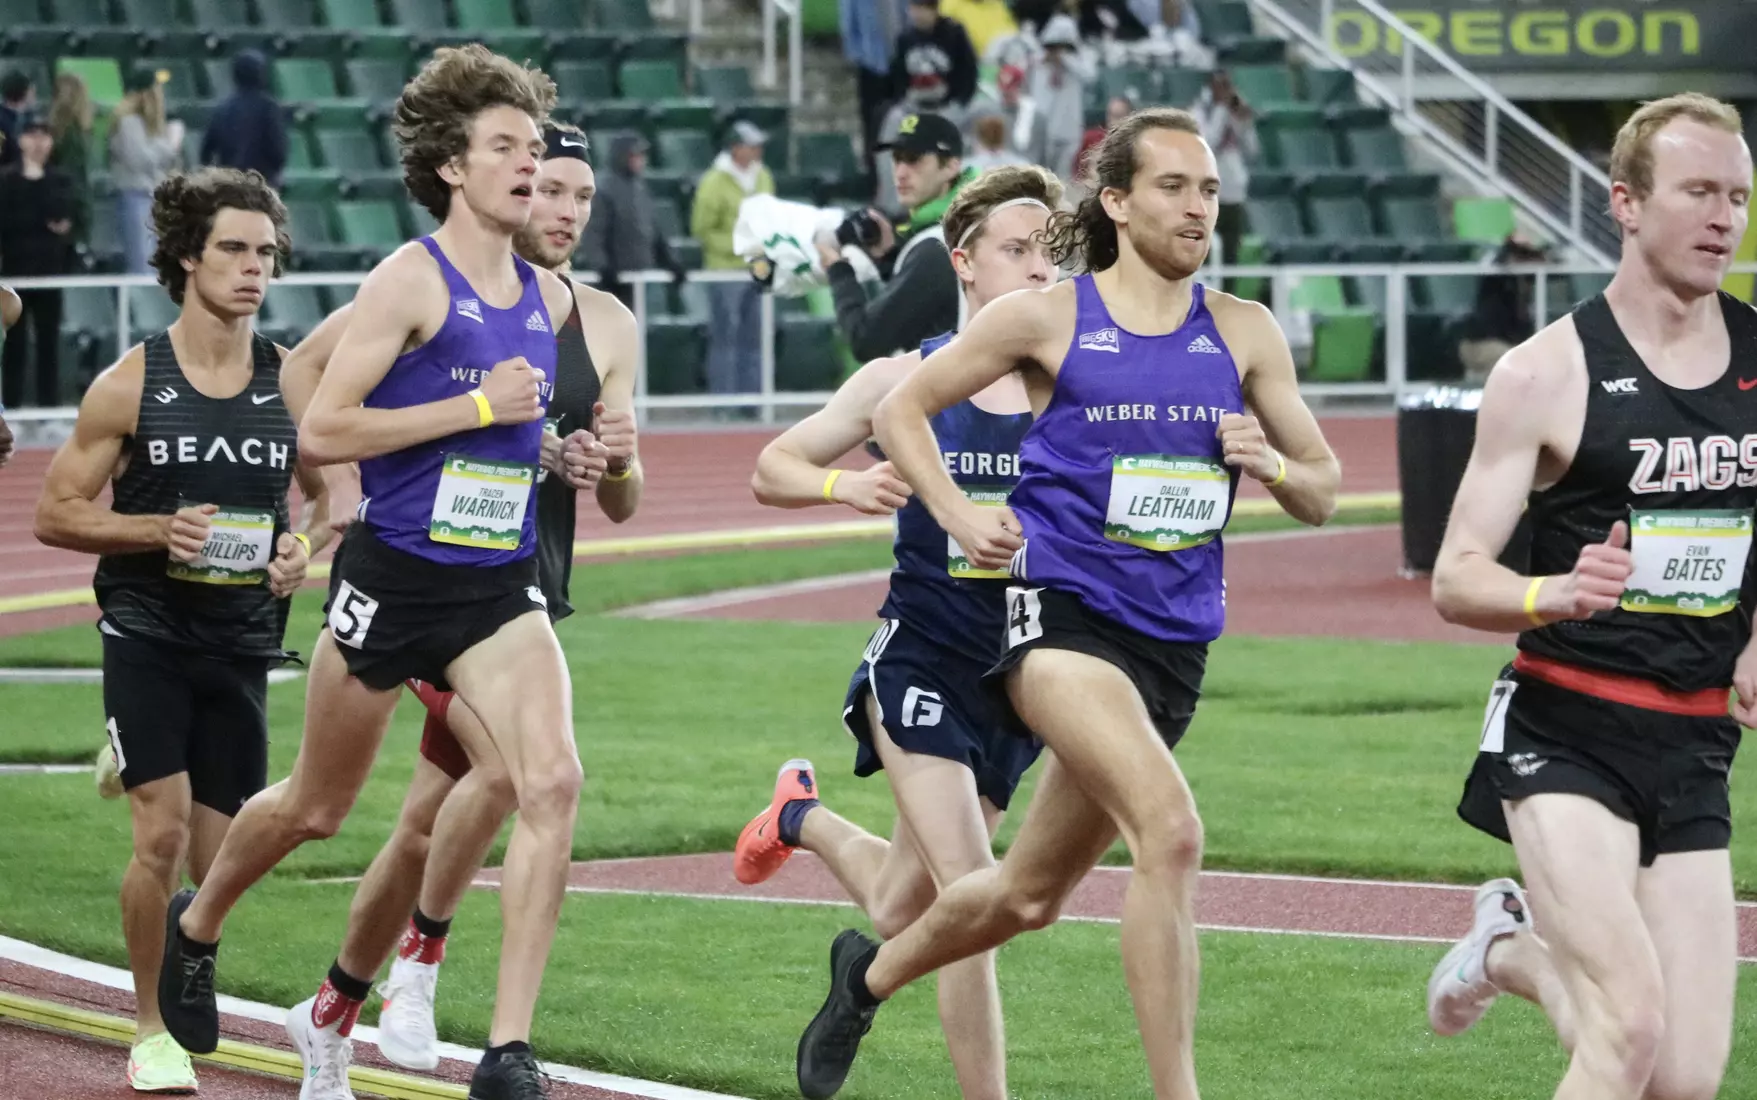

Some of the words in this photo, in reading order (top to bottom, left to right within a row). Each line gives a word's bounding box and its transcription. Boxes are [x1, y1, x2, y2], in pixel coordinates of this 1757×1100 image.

[1330, 9, 1698, 57] OREGON
[1085, 404, 1157, 423] WEBER
[1167, 404, 1228, 423] STATE
[148, 436, 288, 470] BEACH
[1628, 433, 1757, 495] ZAGS
[970, 492, 1008, 502] HAYWARD
[1160, 485, 1191, 496] DALLIN
[451, 494, 520, 520] WARNICK
[1127, 495, 1217, 520] LEATHAM
[200, 541, 260, 562] HILLIPS
[1686, 545, 1711, 557] EVAN
[1662, 558, 1726, 582] BATES
[335, 590, 369, 640] 5
[1011, 593, 1031, 637] 4
[1481, 687, 1507, 745] 7
